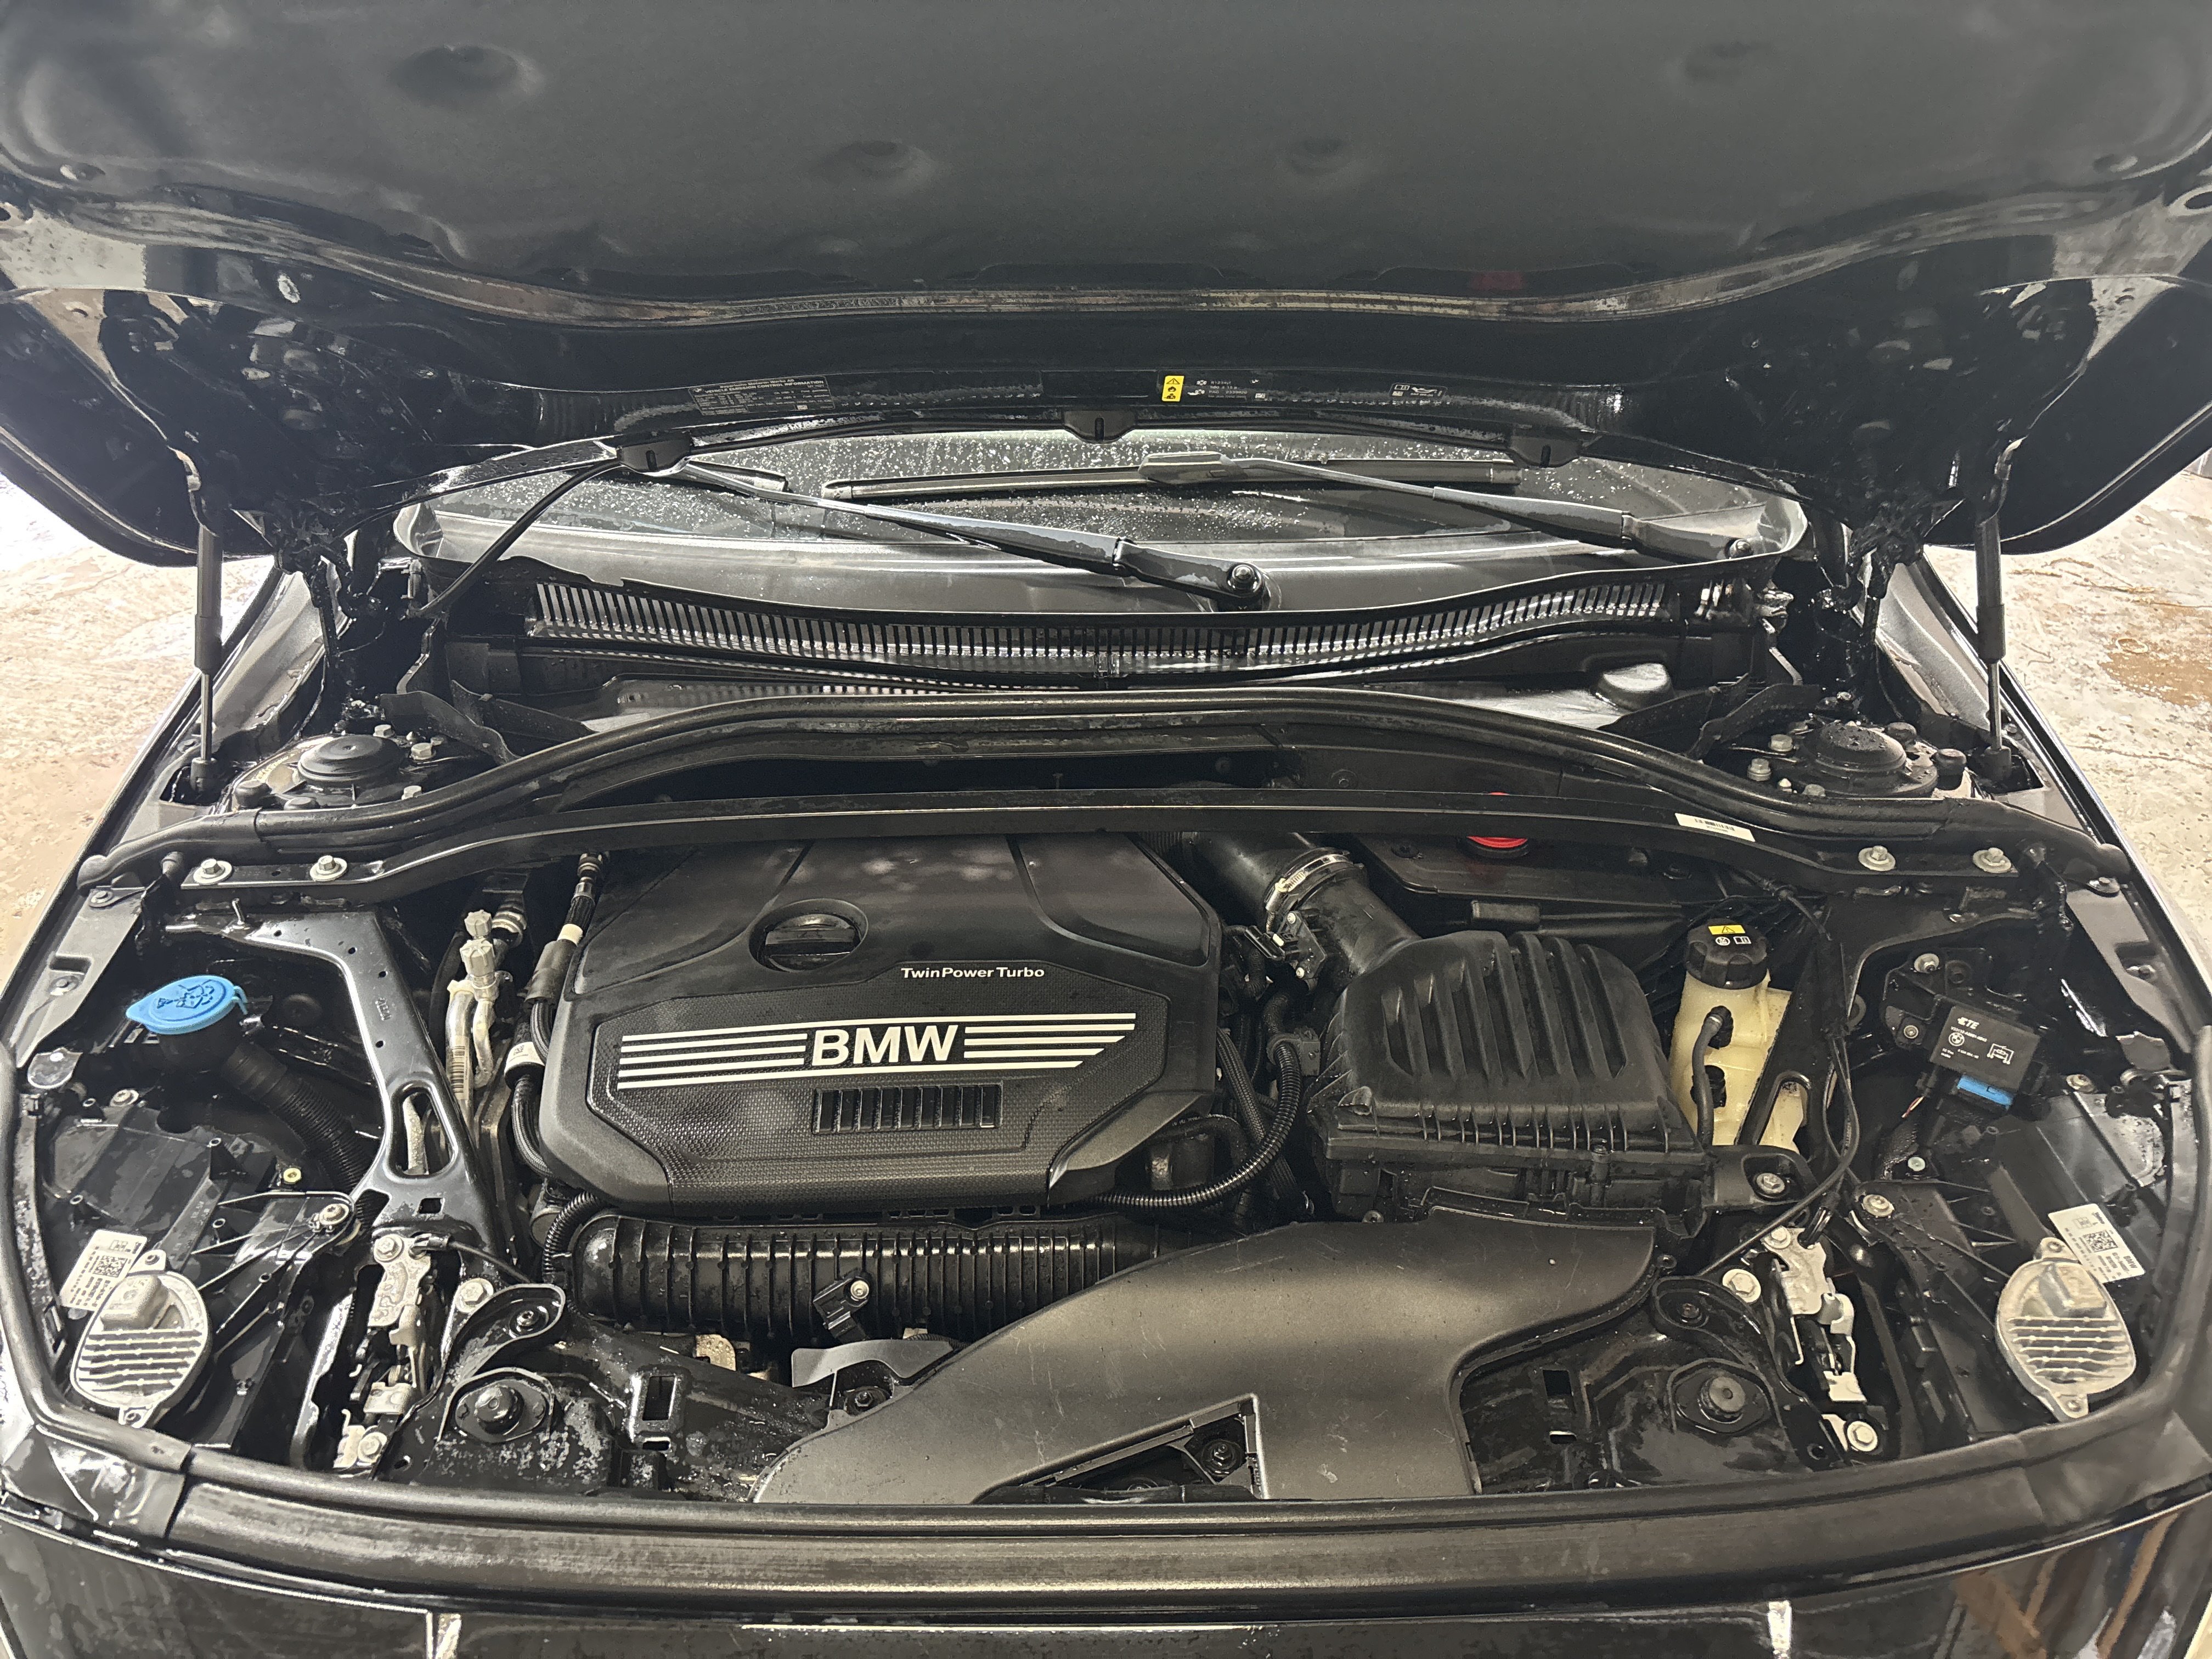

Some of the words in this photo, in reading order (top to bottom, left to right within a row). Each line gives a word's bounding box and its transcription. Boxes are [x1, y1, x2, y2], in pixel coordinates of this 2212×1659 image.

[996, 967, 1045, 978] Turbo
[811, 1024, 959, 1066] BMW
[2123, 1255, 2137, 1268] BMW
